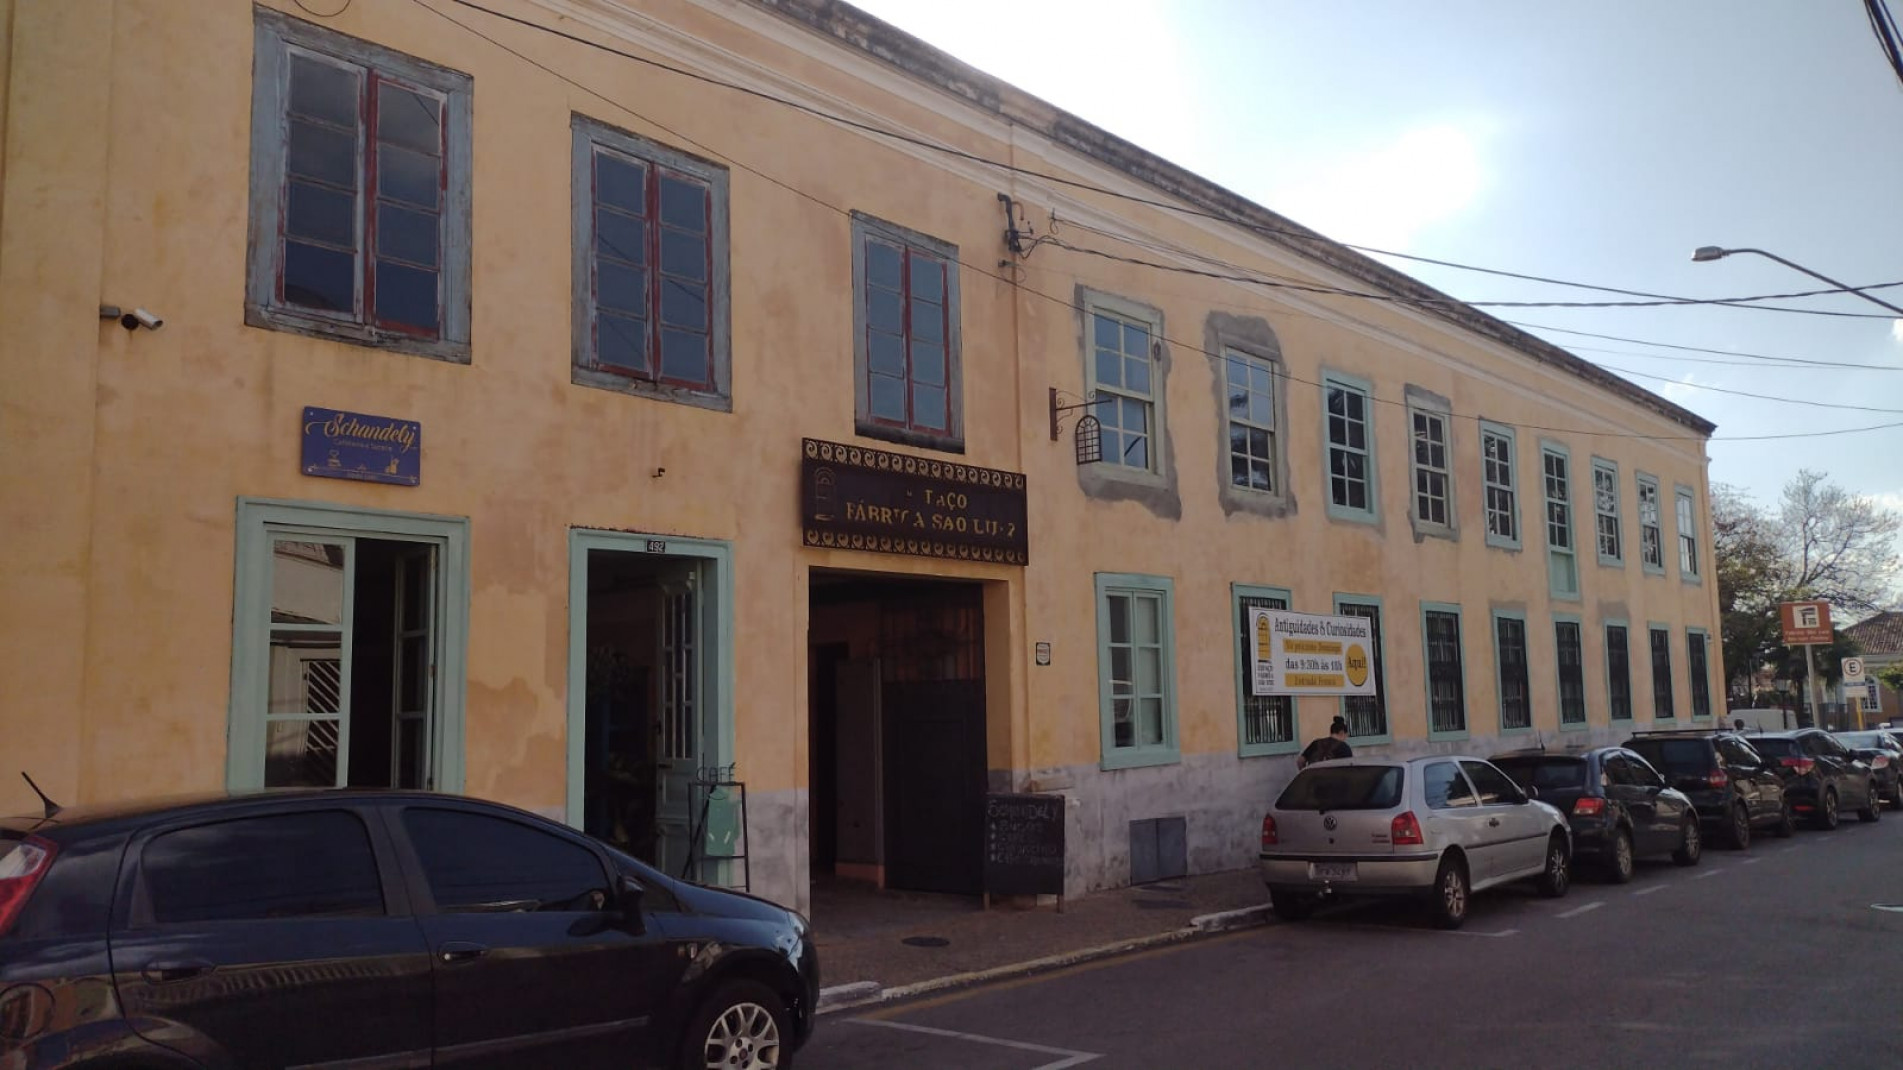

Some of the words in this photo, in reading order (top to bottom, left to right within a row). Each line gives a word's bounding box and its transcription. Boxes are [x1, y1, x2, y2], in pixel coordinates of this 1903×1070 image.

[846, 498, 925, 528] FÁBRA
[648, 541, 664, 552] 492
[1849, 662, 1856, 672] E
[696, 762, 736, 783] CAFÉ
